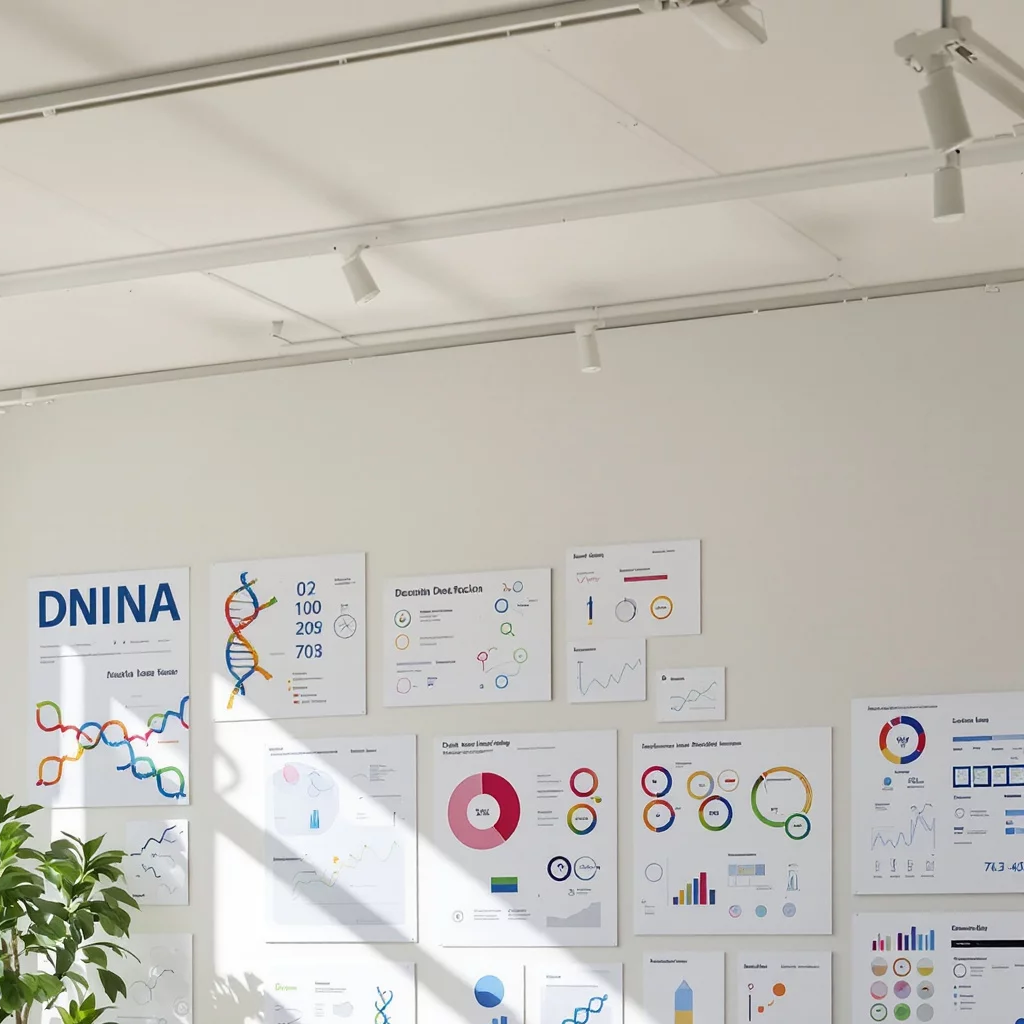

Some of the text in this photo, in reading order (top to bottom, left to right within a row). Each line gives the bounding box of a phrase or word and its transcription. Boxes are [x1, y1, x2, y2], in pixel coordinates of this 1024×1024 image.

[296, 580, 317, 597] 02
[38, 582, 180, 629] DNINA
[295, 600, 322, 616] 100
[295, 620, 323, 636] 209
